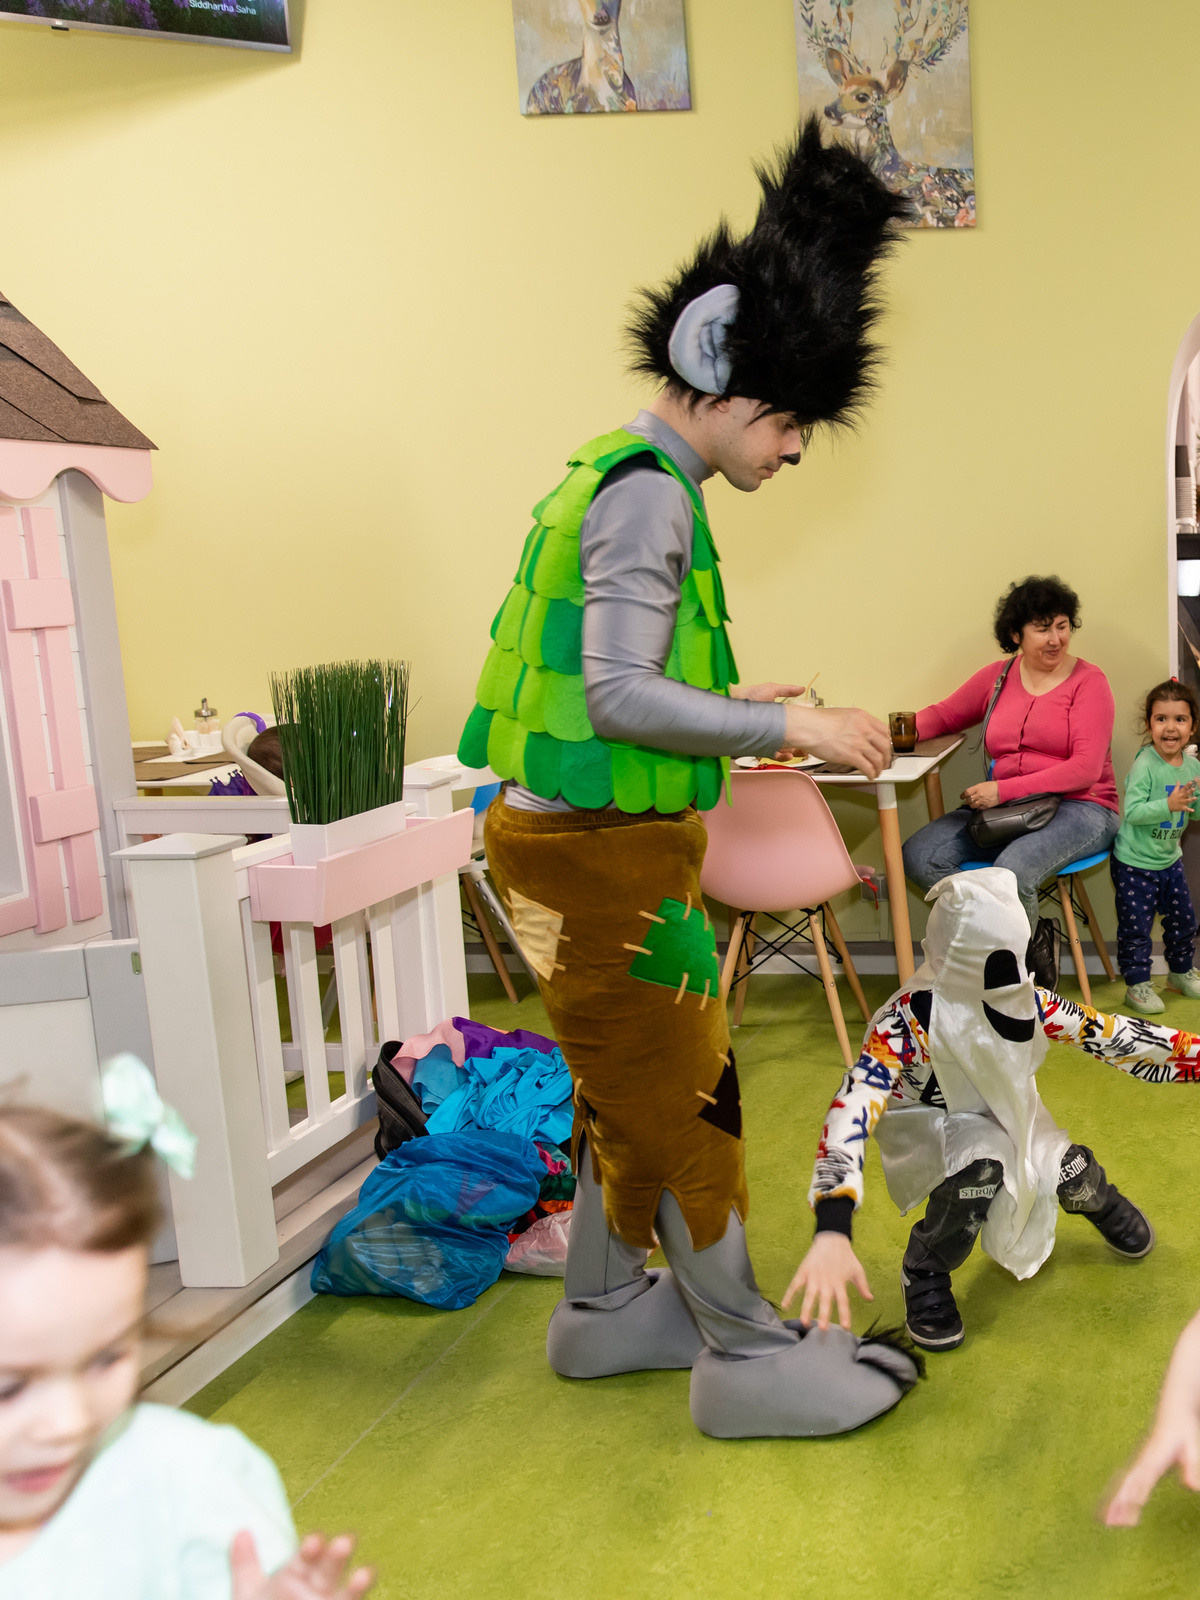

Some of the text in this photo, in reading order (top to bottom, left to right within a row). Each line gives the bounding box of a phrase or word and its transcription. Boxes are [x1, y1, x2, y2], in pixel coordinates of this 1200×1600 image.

[189, 0, 257, 15] Siddhartha Saha
[1151, 828, 1169, 840] SAY
